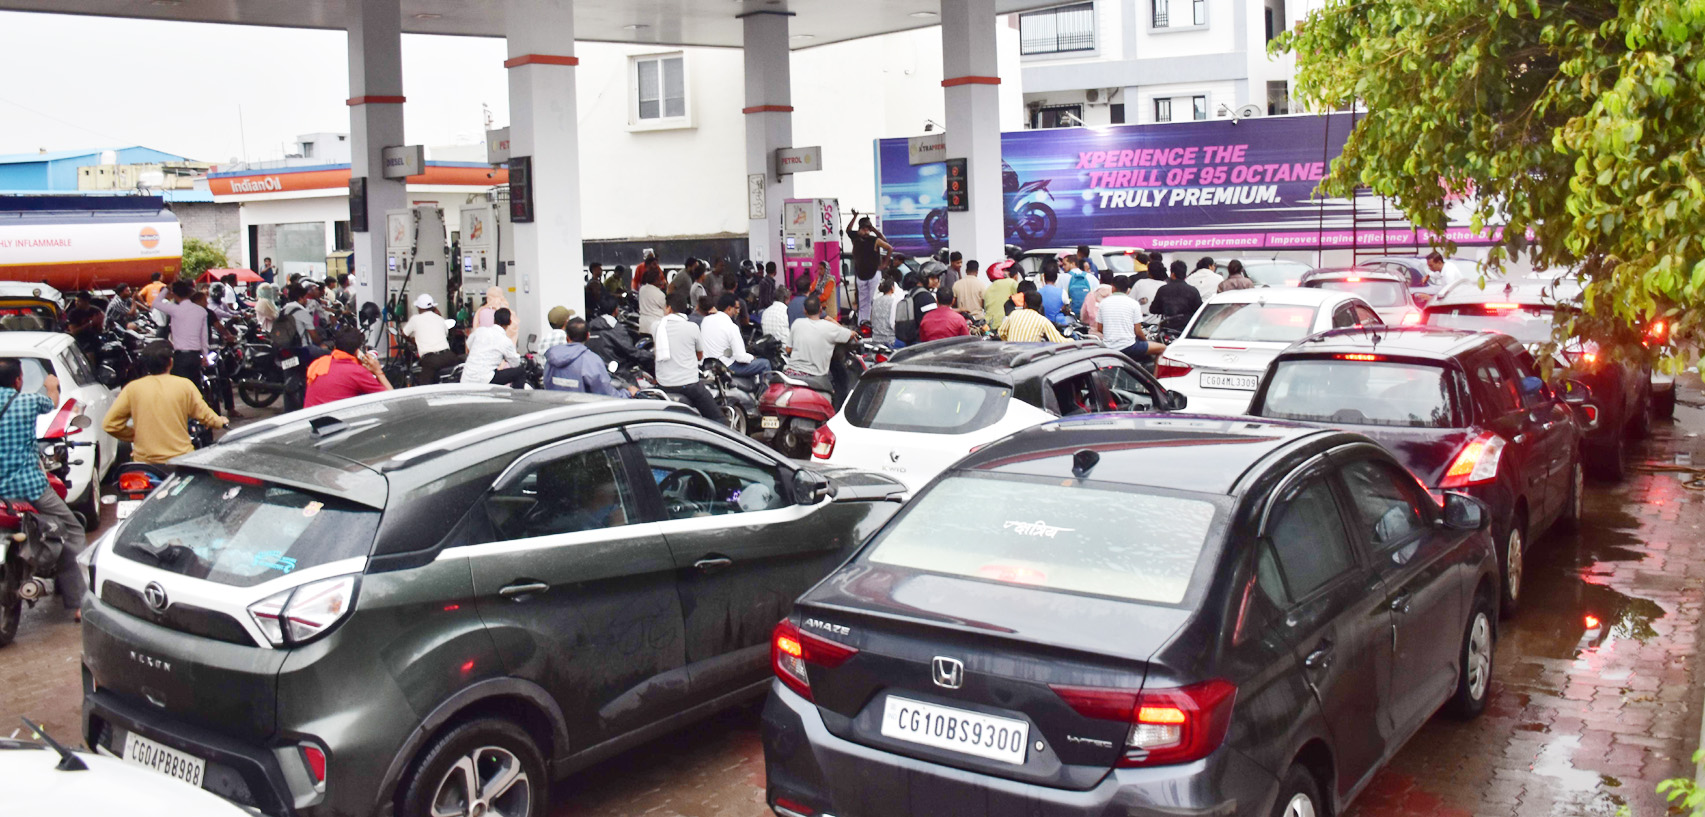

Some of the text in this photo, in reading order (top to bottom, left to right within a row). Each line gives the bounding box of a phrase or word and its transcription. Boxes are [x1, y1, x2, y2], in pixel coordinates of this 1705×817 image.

[781, 156, 803, 165] PETROL
[1076, 144, 1248, 169] XPERIENCE THE
[230, 177, 282, 192] IndianOil
[1089, 169, 1162, 189] THRILL
[1166, 167, 1198, 186] OF
[1200, 166, 1228, 185] 95
[1099, 184, 1282, 209] TRULY PREMIUM.
[15, 238, 72, 248] INFLAMMABLE
[1152, 237, 1258, 248] Superior performance
[1270, 231, 1409, 245] Improves engine efficiency
[1206, 376, 1256, 388] CG04ML3309
[804, 617, 851, 636] AMAZE
[130, 650, 171, 672] NEXON
[898, 707, 1022, 753] CG10BS9300
[132, 739, 201, 786] CG04PB8988
